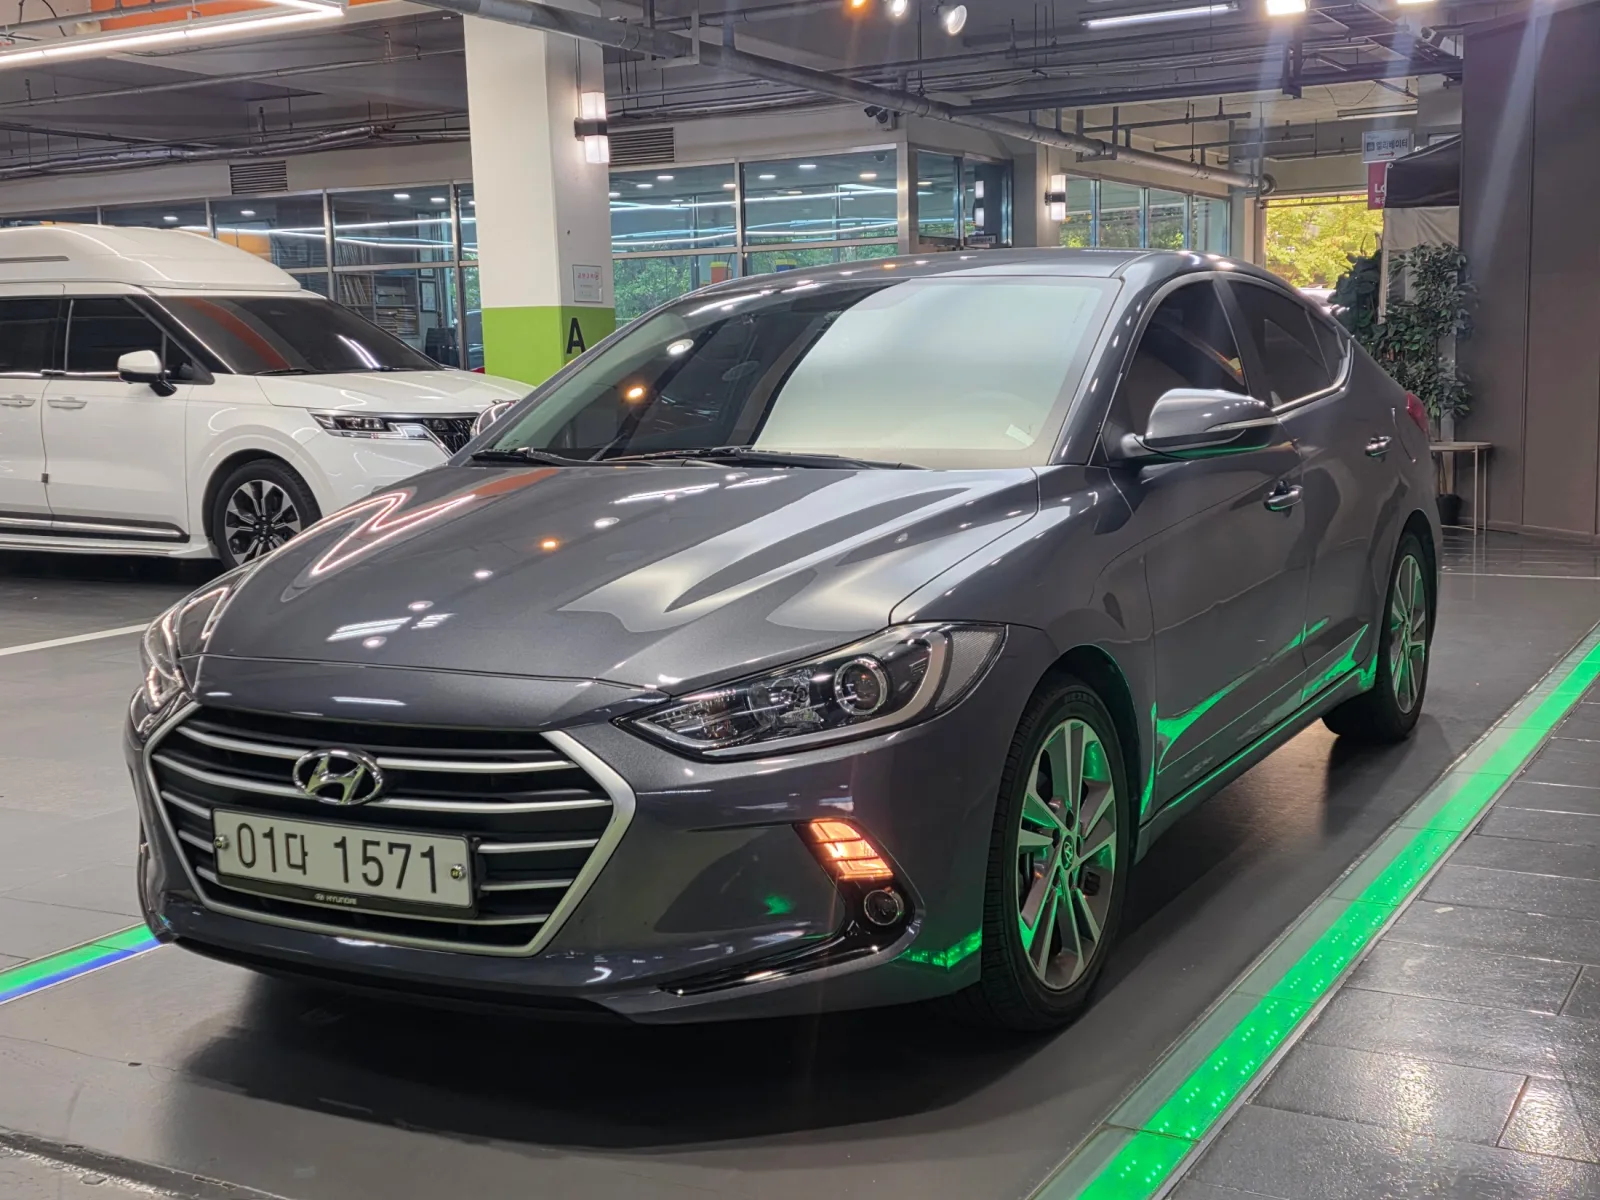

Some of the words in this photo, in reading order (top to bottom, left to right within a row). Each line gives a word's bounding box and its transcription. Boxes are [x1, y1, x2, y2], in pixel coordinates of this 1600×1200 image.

[1376, 138, 1408, 150] 엘리베이터
[566, 317, 587, 354] A
[236, 822, 308, 876] 01다
[333, 835, 437, 894] 1571
[326, 895, 358, 905] HYUNDAI
